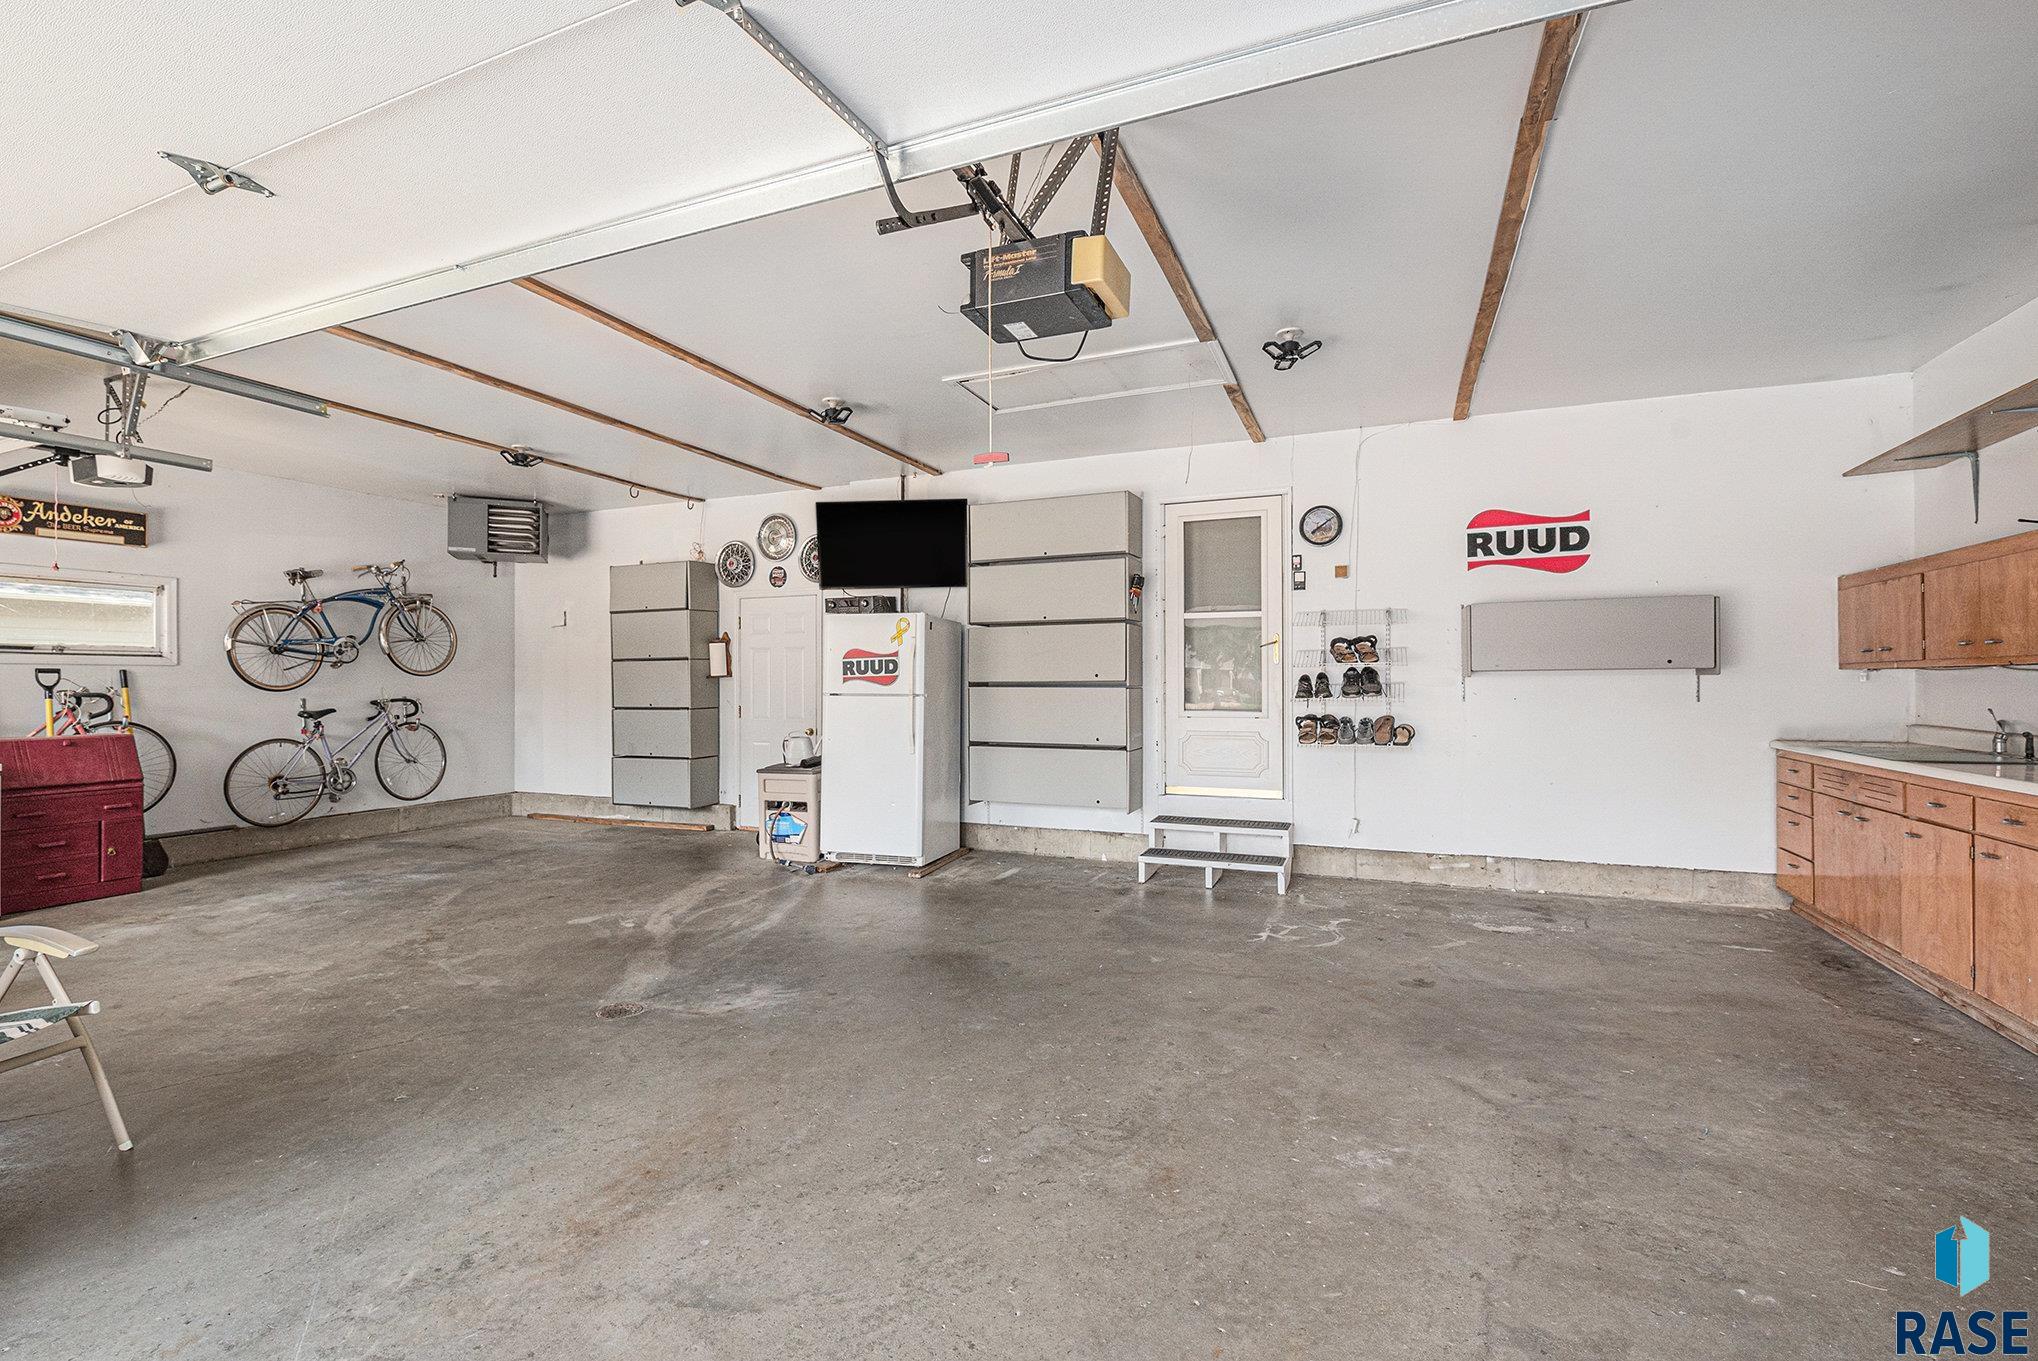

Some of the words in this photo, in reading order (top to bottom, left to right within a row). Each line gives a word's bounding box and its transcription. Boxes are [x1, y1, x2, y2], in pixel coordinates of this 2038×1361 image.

[22, 501, 117, 527] Andeker
[62, 522, 81, 531] BEER
[114, 523, 145, 531] AMERICA
[1466, 525, 1590, 558] RUUD
[842, 659, 899, 676] RUUD
